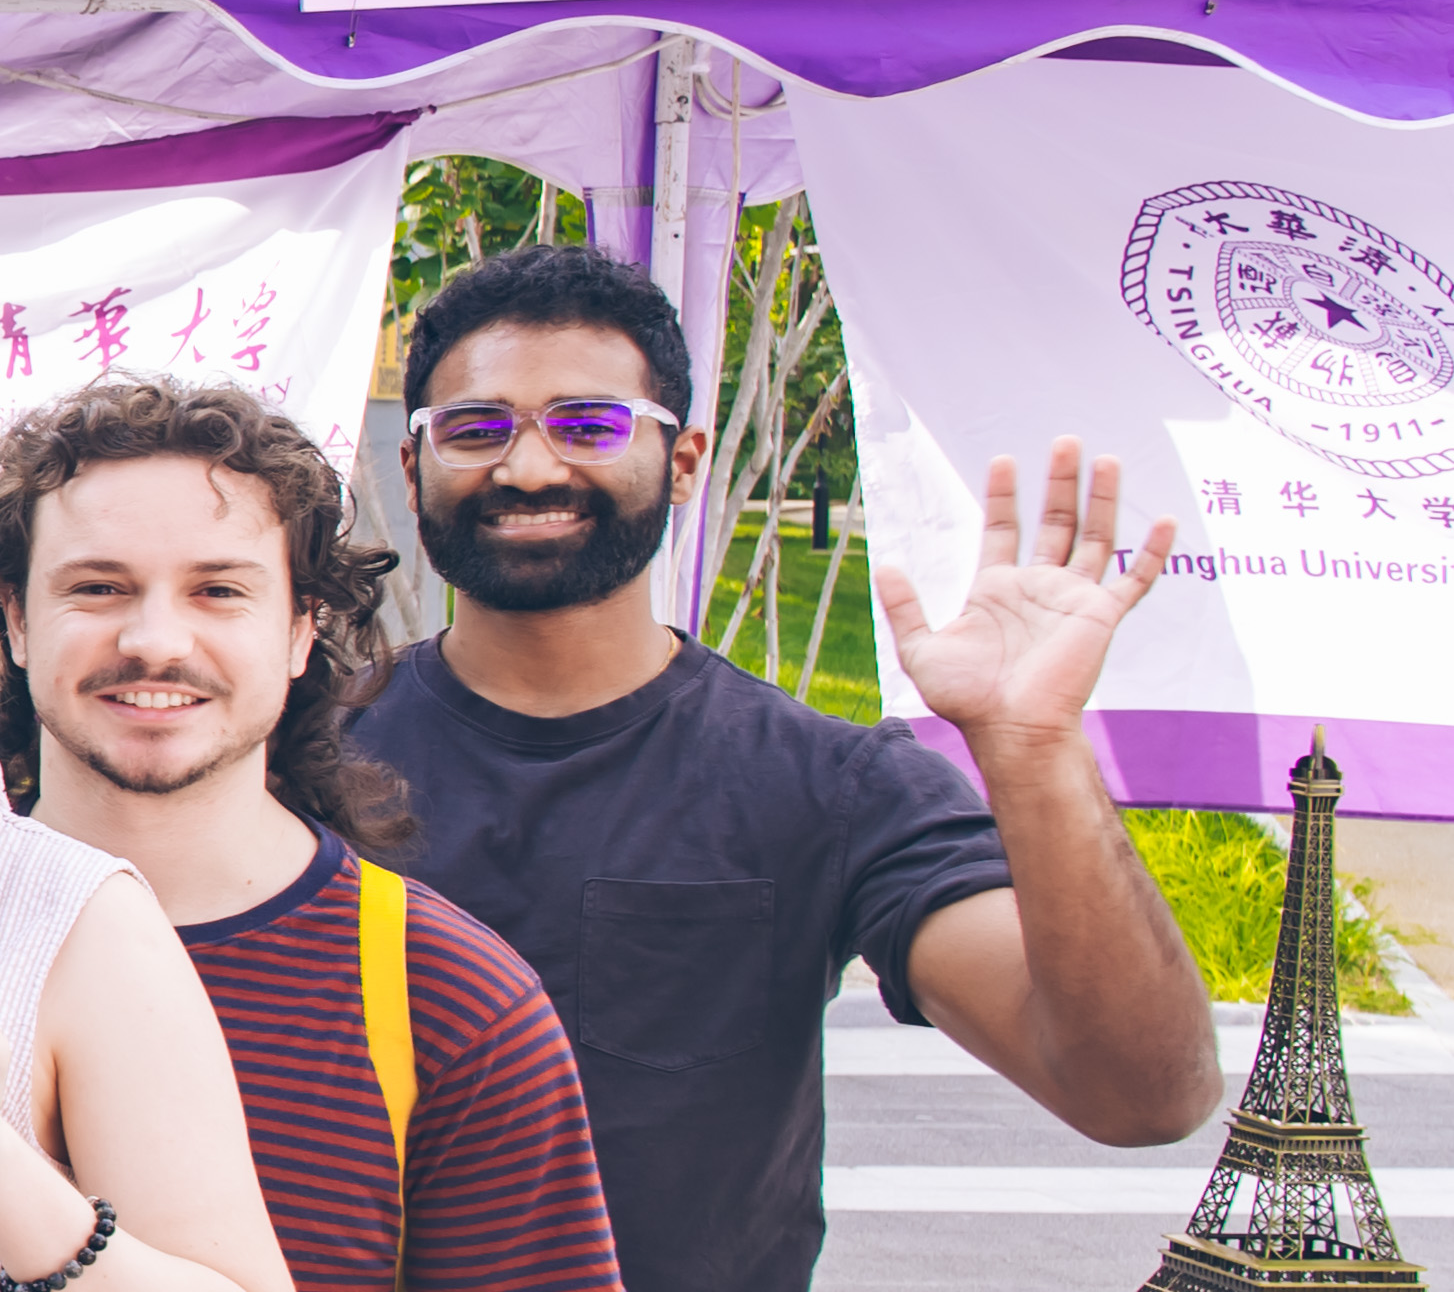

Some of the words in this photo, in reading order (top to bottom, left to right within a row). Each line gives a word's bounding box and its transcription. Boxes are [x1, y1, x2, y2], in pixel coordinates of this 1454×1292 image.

[1166, 264, 1274, 413] TSINGHUA
[1201, 478, 1454, 529] 清华大学
[1112, 547, 1288, 582] Tnghua
[1299, 548, 1454, 585] Universi
